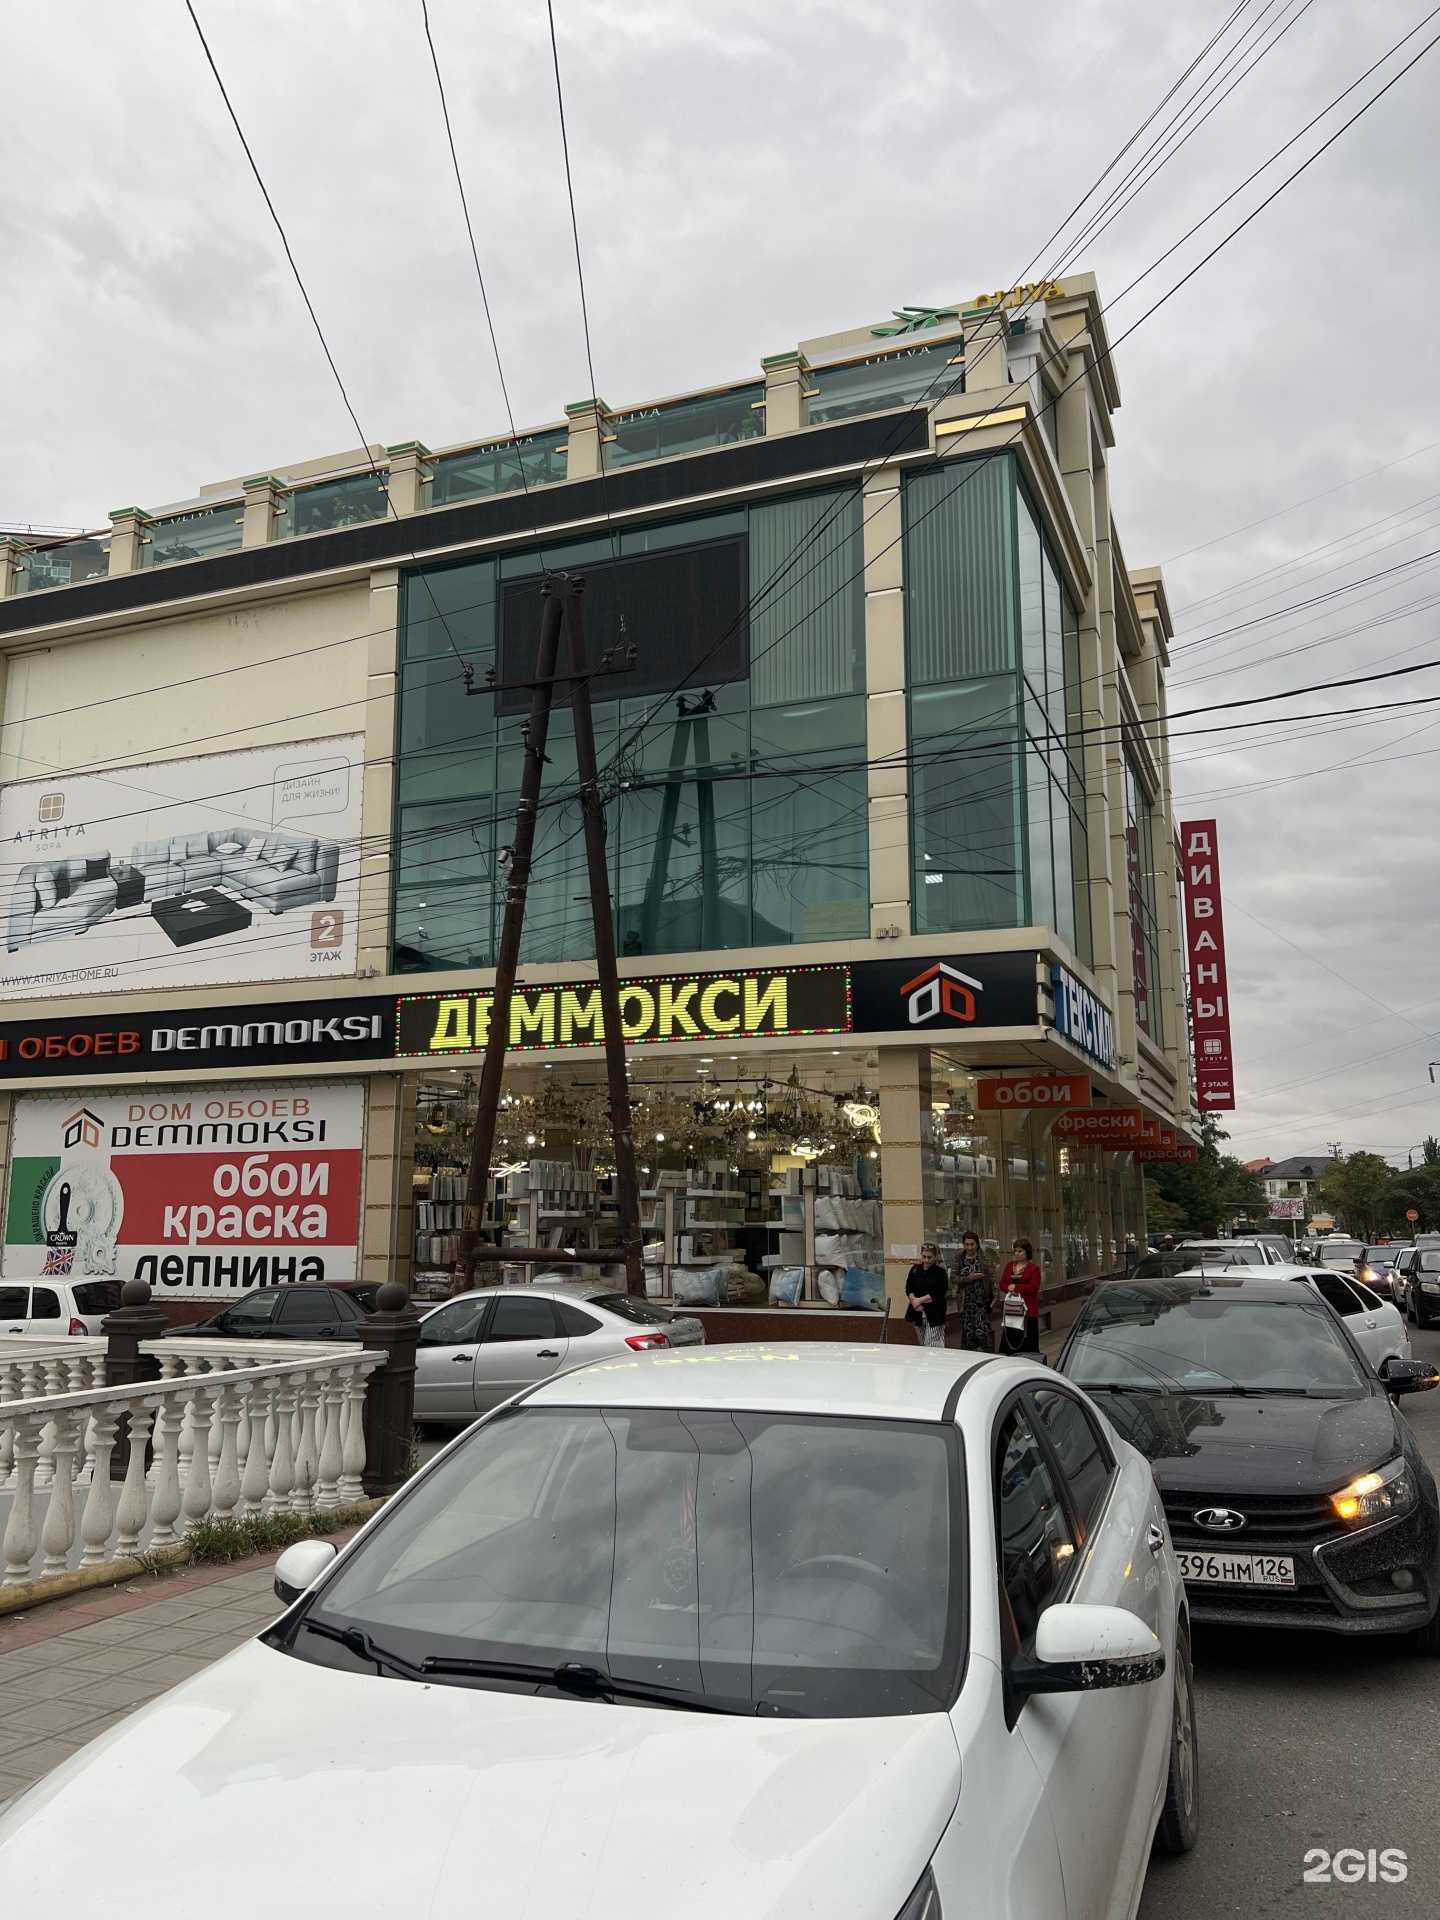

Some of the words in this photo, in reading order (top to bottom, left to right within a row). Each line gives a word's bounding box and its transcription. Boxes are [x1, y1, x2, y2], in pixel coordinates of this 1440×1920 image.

[13, 825, 86, 843] ATRIYA
[36, 841, 62, 852] SOFA
[318, 915, 336, 942] 2
[1187, 831, 1224, 1018] ДИВАНЫ
[310, 951, 342, 962] ЭТАЖ
[1, 967, 119, 987] WWW.ATRIYA-HOME.RU
[430, 976, 788, 1050] ДЕММОКСИ
[18, 1031, 142, 1060] ОБОЕВ
[995, 1082, 1072, 1104] обои
[204, 1098, 310, 1120] ОБОЕВ
[1057, 1114, 1136, 1130] фрески
[213, 1154, 330, 1197] обои
[163, 1203, 328, 1246] краска
[50, 1232, 74, 1242] CROWN
[133, 1254, 325, 1288] лепнина
[1255, 1559, 1288, 1576] 126
[1263, 1575, 1280, 1583] RUS
